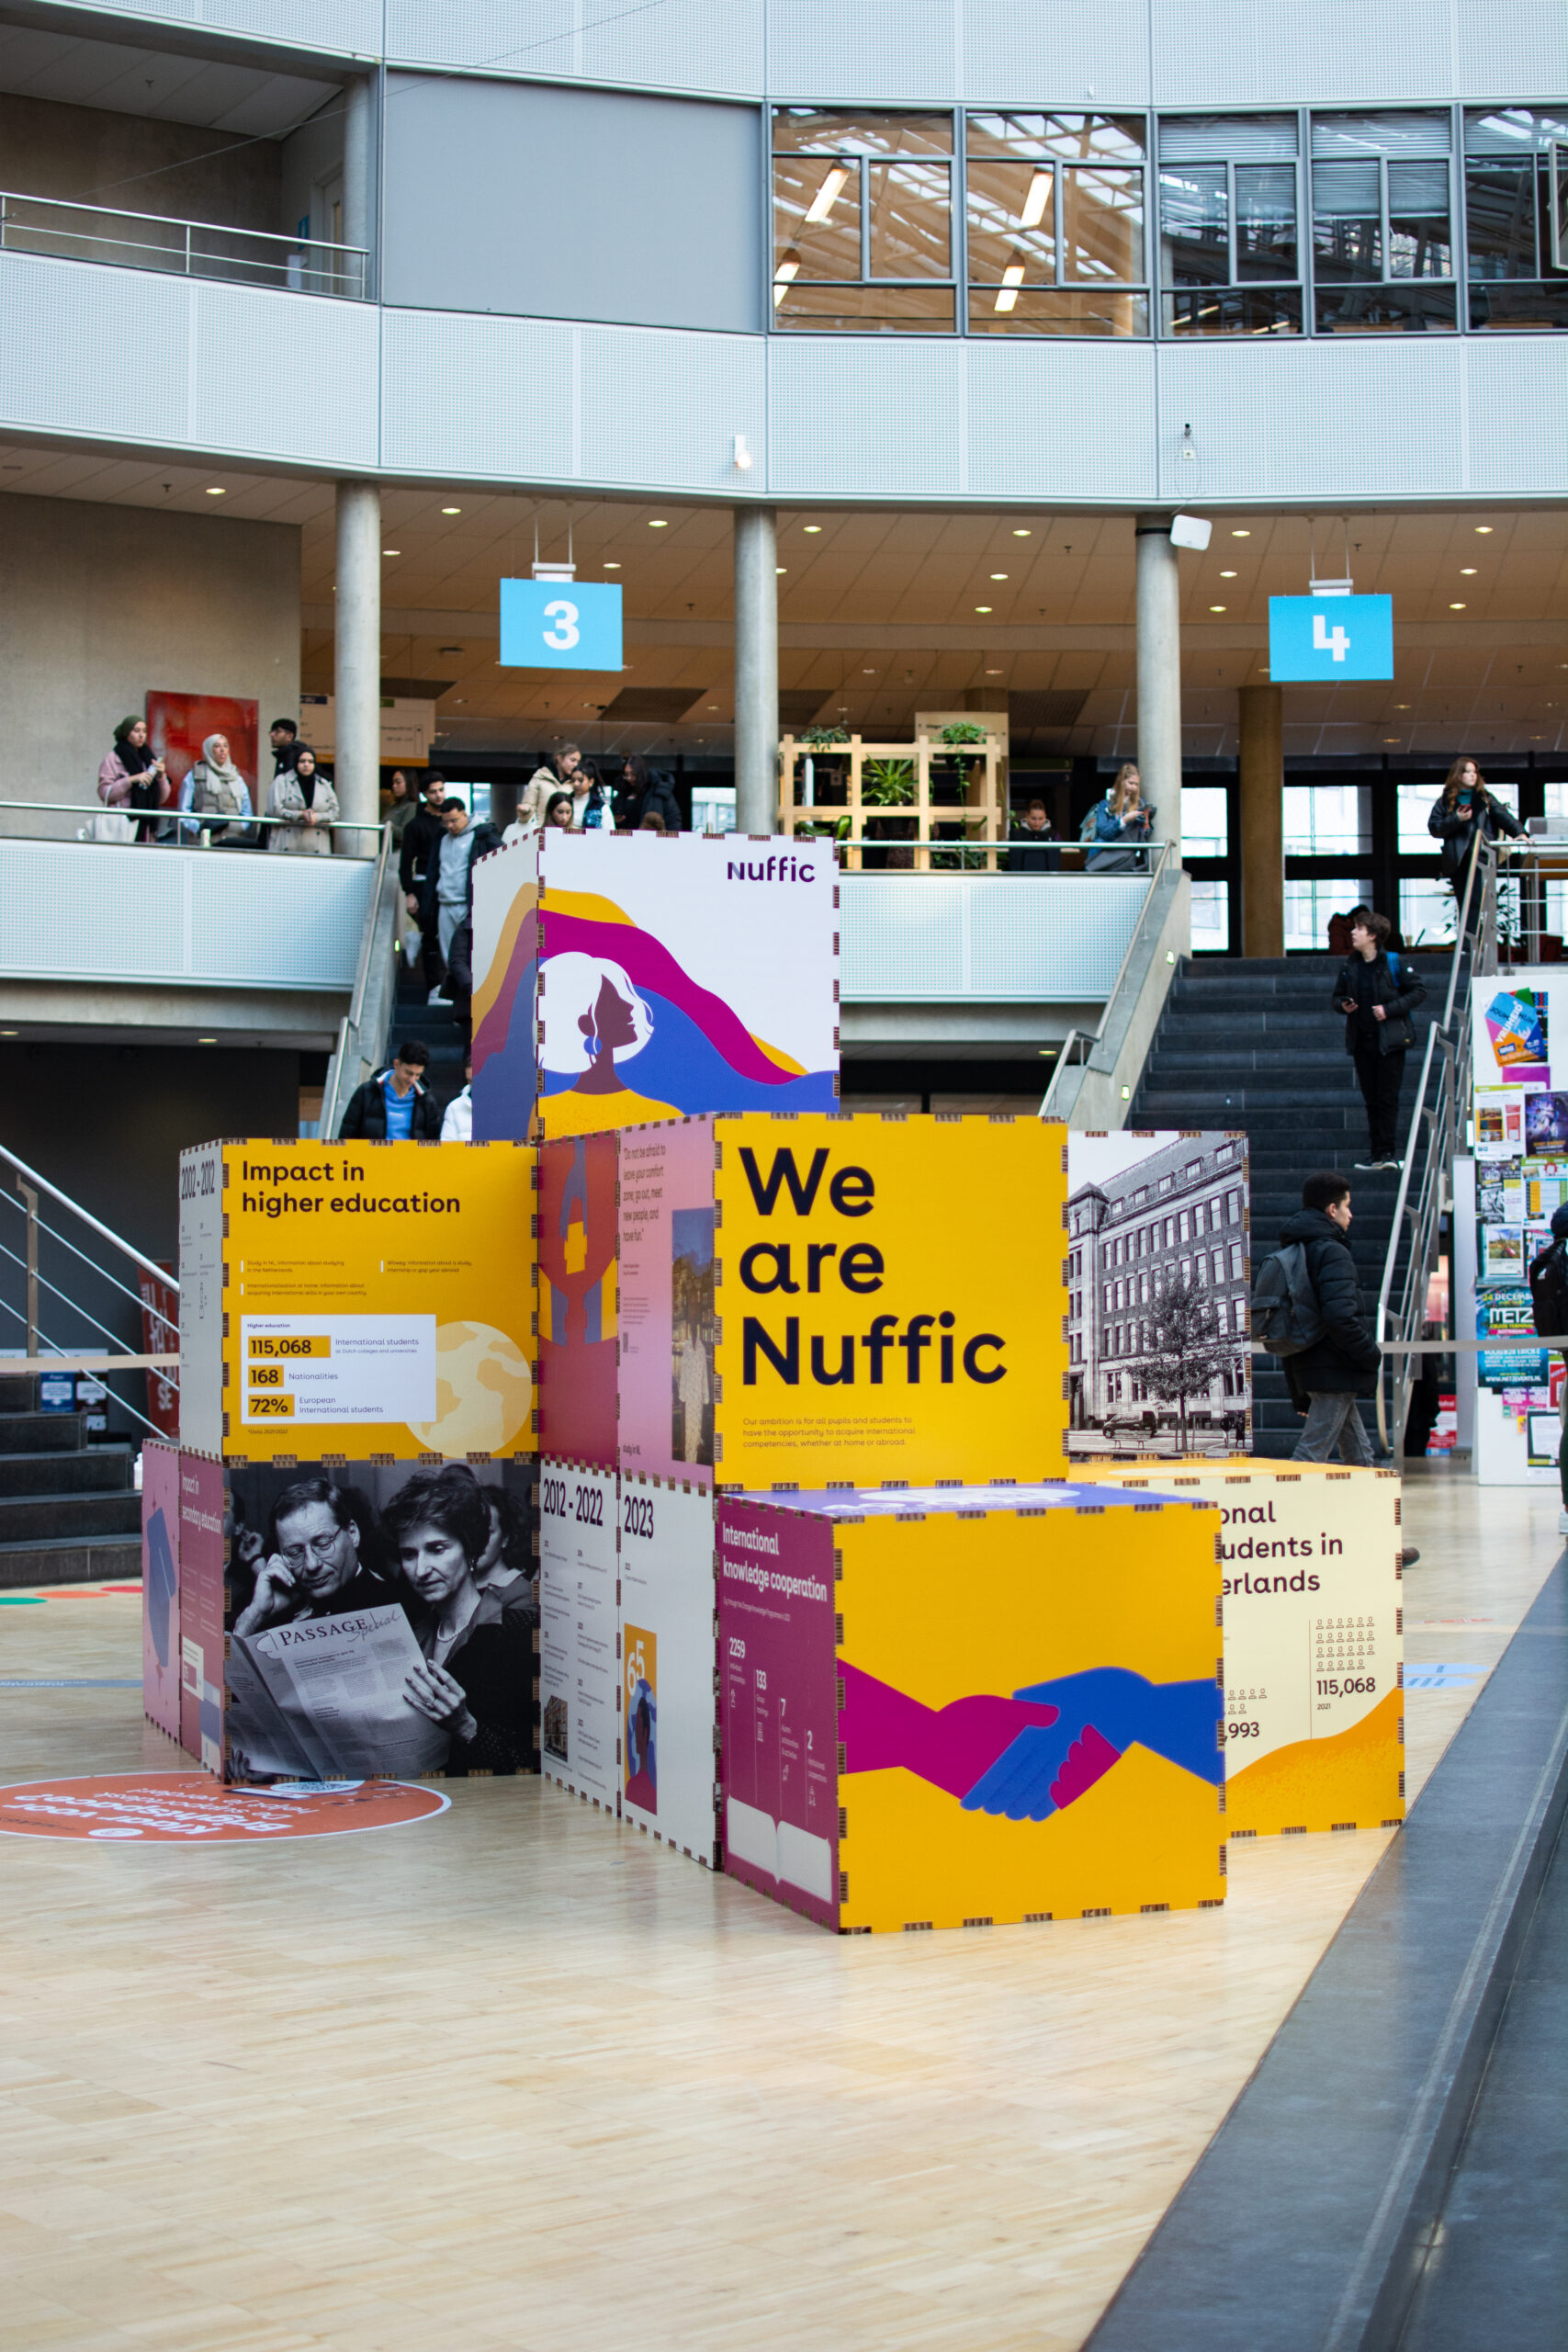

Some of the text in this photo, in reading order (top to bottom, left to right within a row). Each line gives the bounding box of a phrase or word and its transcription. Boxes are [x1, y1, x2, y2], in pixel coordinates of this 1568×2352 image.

[543, 600, 581, 650] 3
[1313, 615, 1351, 662] 4
[660, 1145, 666, 1156] to
[182, 1164, 196, 1200] 2002
[201, 1159, 215, 1195] 2012
[243, 1159, 365, 1186] Impact in
[739, 1147, 875, 1218] We
[243, 1192, 460, 1218] higher education
[739, 1241, 885, 1295] are
[1490, 1307, 1534, 1323] METZ
[251, 1340, 311, 1357] 115,068
[335, 1338, 420, 1346] International students
[742, 1310, 1008, 1385] Nuffic
[251, 1369, 279, 1384] 168
[251, 1398, 288, 1413] 72%
[299, 1396, 336, 1405] European
[299, 1406, 384, 1414] International students
[829, 1417, 852, 1426] pupils
[870, 1416, 902, 1424] students
[743, 1429, 762, 1437] have
[778, 1429, 824, 1438] opportunity
[836, 1429, 864, 1437] acquire
[743, 1441, 799, 1449] competencies,
[543, 1477, 567, 1518] 2012
[575, 1485, 604, 1527] 2022
[624, 1494, 654, 1539] 2023
[723, 1521, 780, 1555] International
[1320, 1532, 1343, 1555] in
[723, 1554, 828, 1602] knowledge cooperation
[279, 1617, 367, 1646] PASSAGE
[729, 1636, 746, 1658] 2259
[626, 1640, 645, 1697] 65
[756, 1669, 767, 1690] 133
[1316, 1677, 1376, 1699] 115,068
[781, 1698, 786, 1716] 7
[1316, 1702, 1331, 1711] 2021
[807, 1730, 813, 1750] 2
[2, 1804, 98, 1818] voor
[14, 1793, 294, 1832] Brightspace?
[96, 1815, 223, 1835] Klaar
